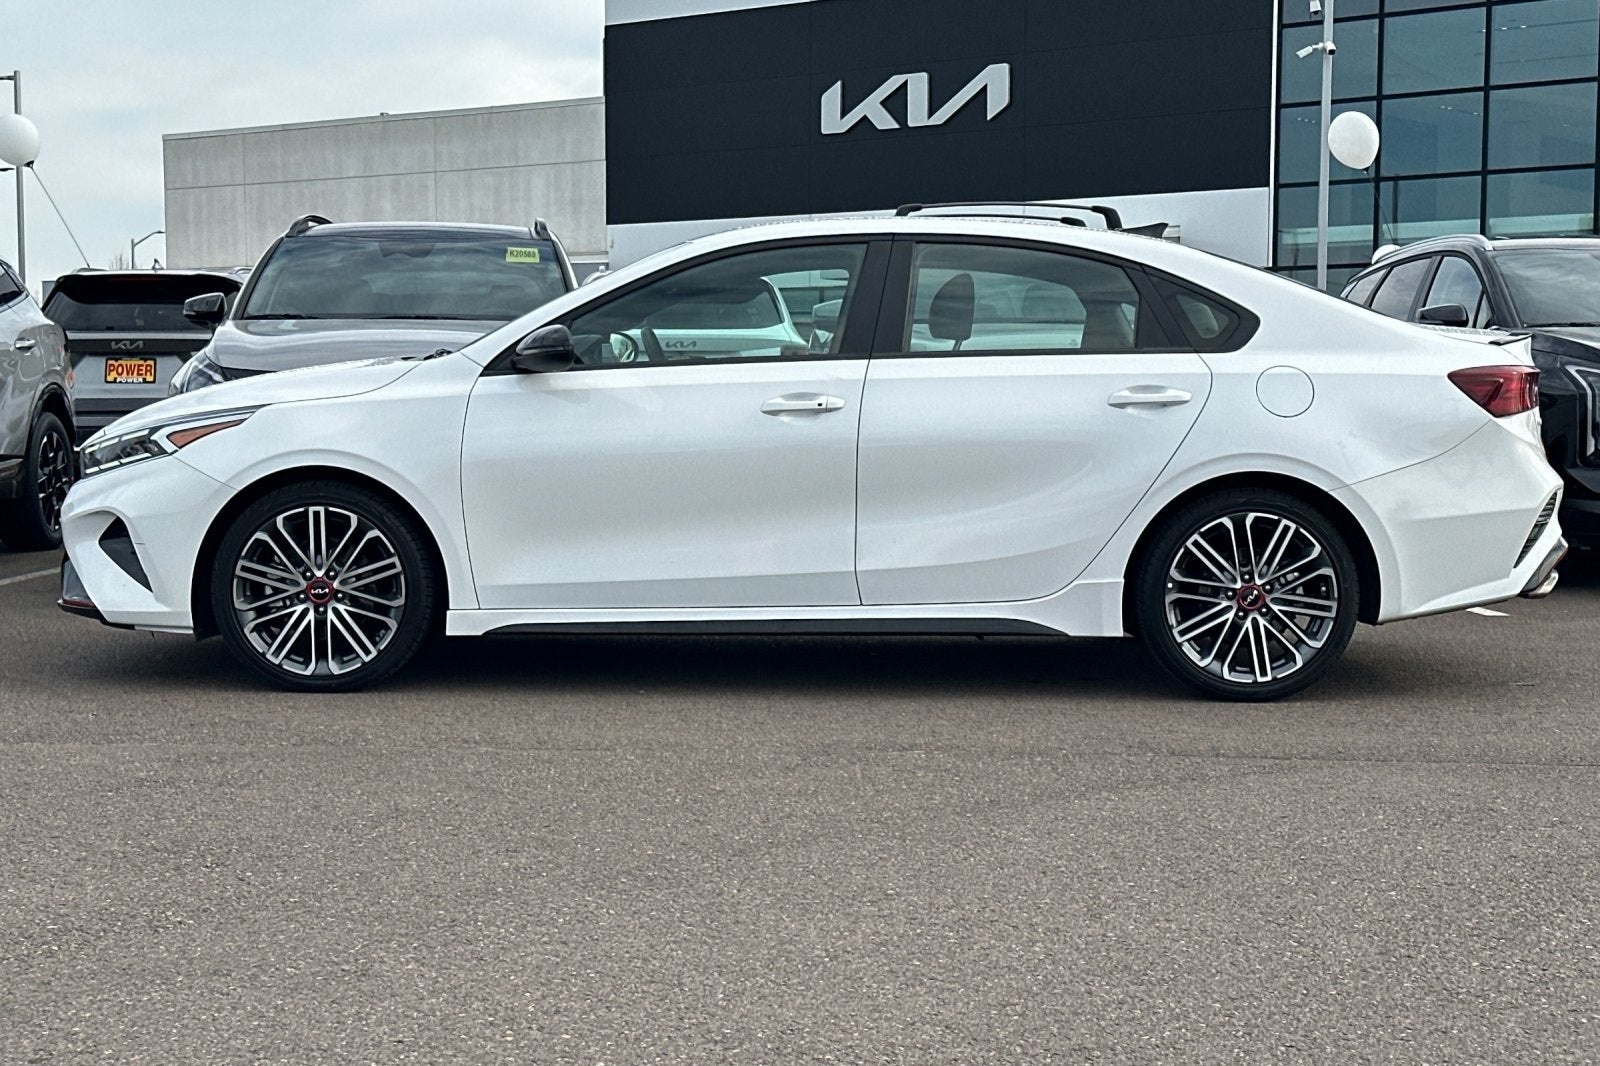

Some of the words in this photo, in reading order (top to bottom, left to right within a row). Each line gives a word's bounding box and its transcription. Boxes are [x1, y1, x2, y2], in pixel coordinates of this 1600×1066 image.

[821, 63, 1010, 134] KIA
[111, 340, 143, 349] KIA
[665, 340, 697, 348] KIA
[108, 363, 153, 376] POWER
